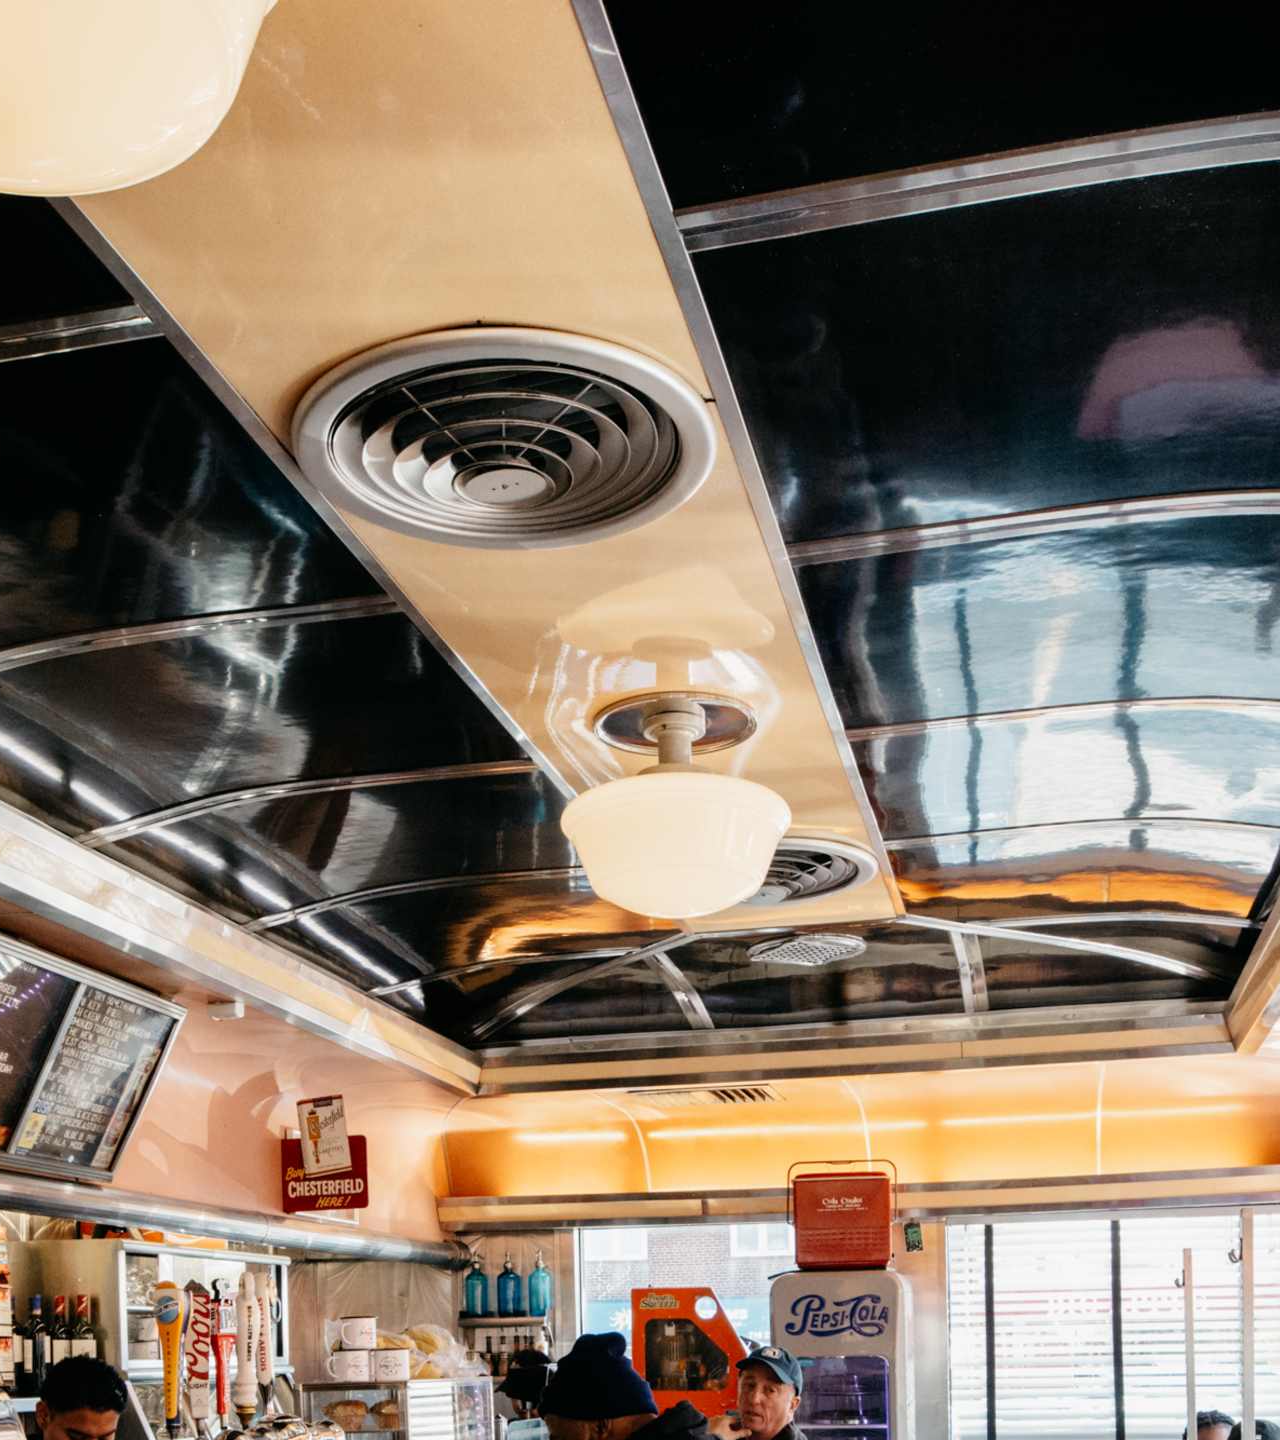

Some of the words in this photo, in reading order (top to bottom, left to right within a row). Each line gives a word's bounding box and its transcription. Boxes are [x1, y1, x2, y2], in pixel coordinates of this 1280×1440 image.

[288, 1178, 364, 1198] CHESTERFIELD
[186, 1293, 211, 1381] Coors
[259, 1337, 267, 1372] ARTOIS
